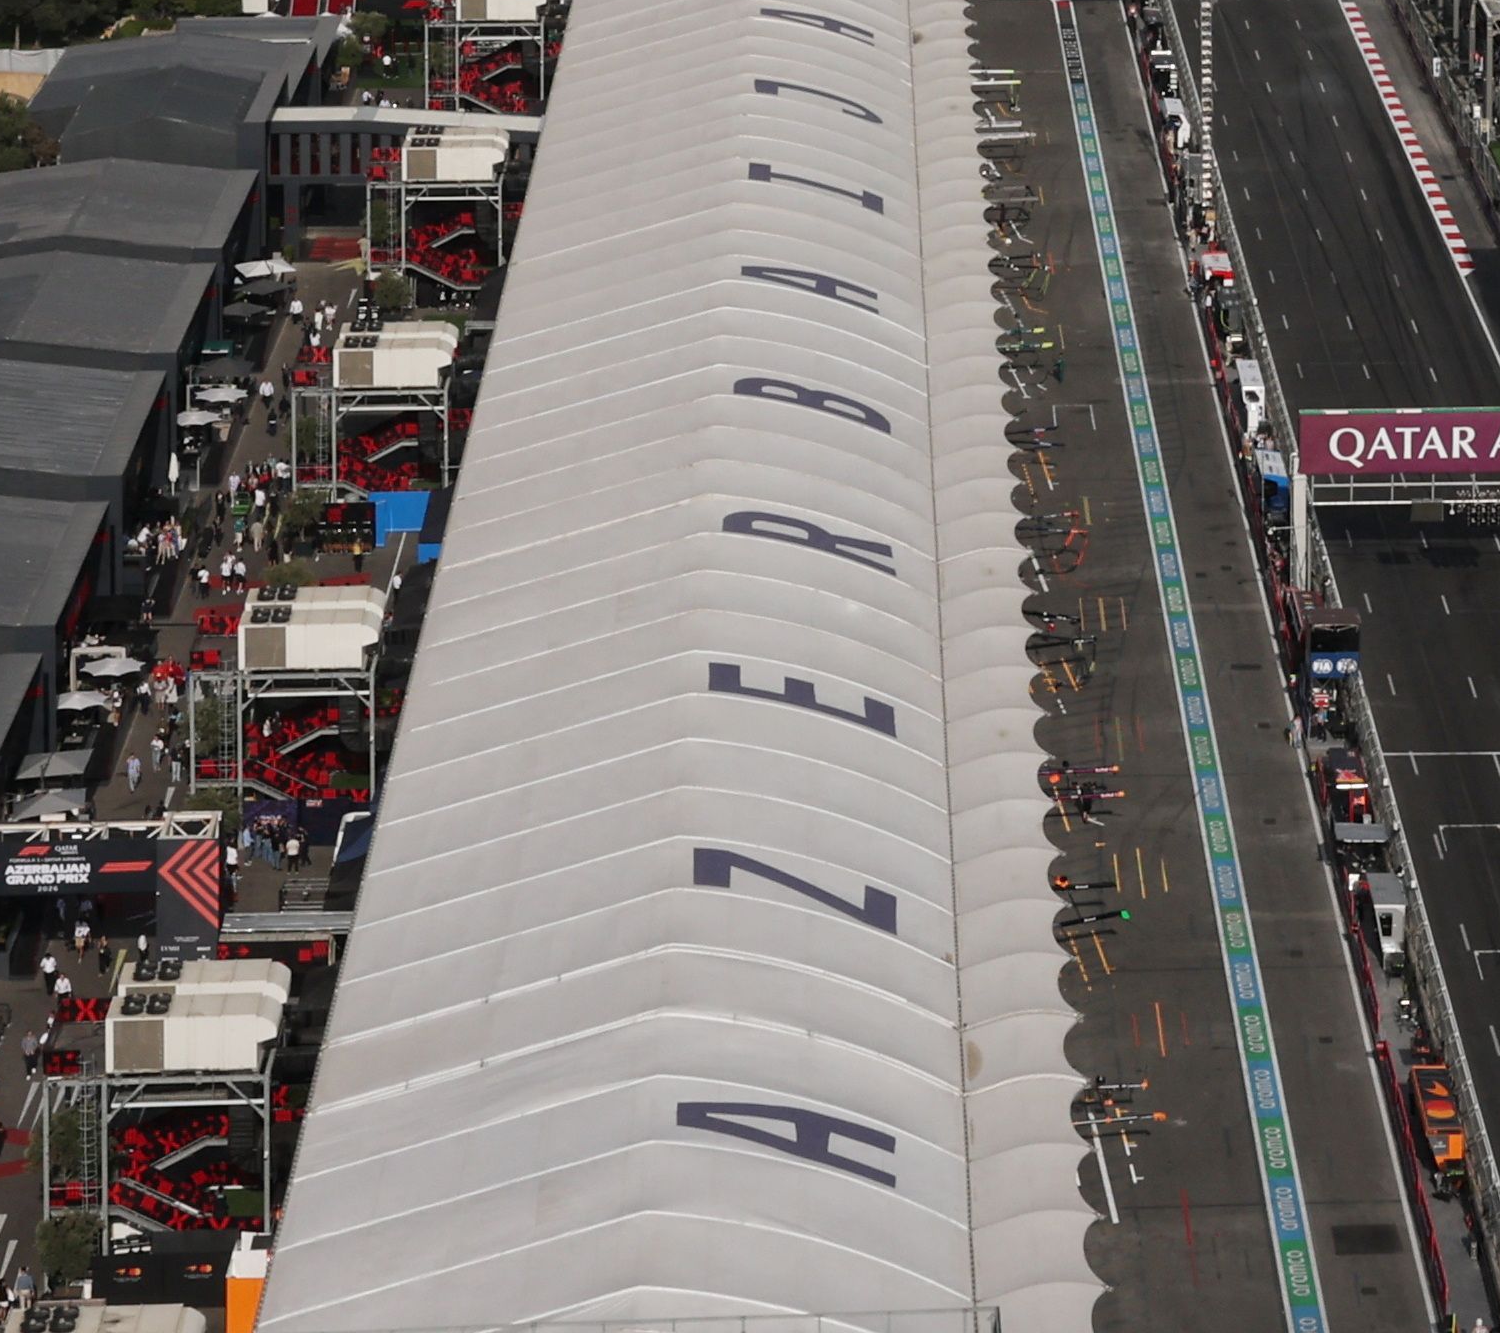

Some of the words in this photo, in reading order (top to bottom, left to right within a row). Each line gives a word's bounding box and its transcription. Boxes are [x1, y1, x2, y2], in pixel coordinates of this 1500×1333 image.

[1329, 425, 1478, 468] QATAR
[5, 863, 91, 875] AZERBAIJAN
[5, 874, 55, 885] GRAND
[57, 874, 89, 884] PRIX
[1218, 866, 1235, 898] aramco
[1226, 913, 1244, 947] aramco
[1237, 964, 1253, 999] aramco
[1246, 1015, 1263, 1052] aramco
[1256, 1070, 1273, 1108] aramco
[1266, 1127, 1285, 1168] aramco
[1278, 1188, 1296, 1230] aramco
[1289, 1250, 1308, 1296] aramco
